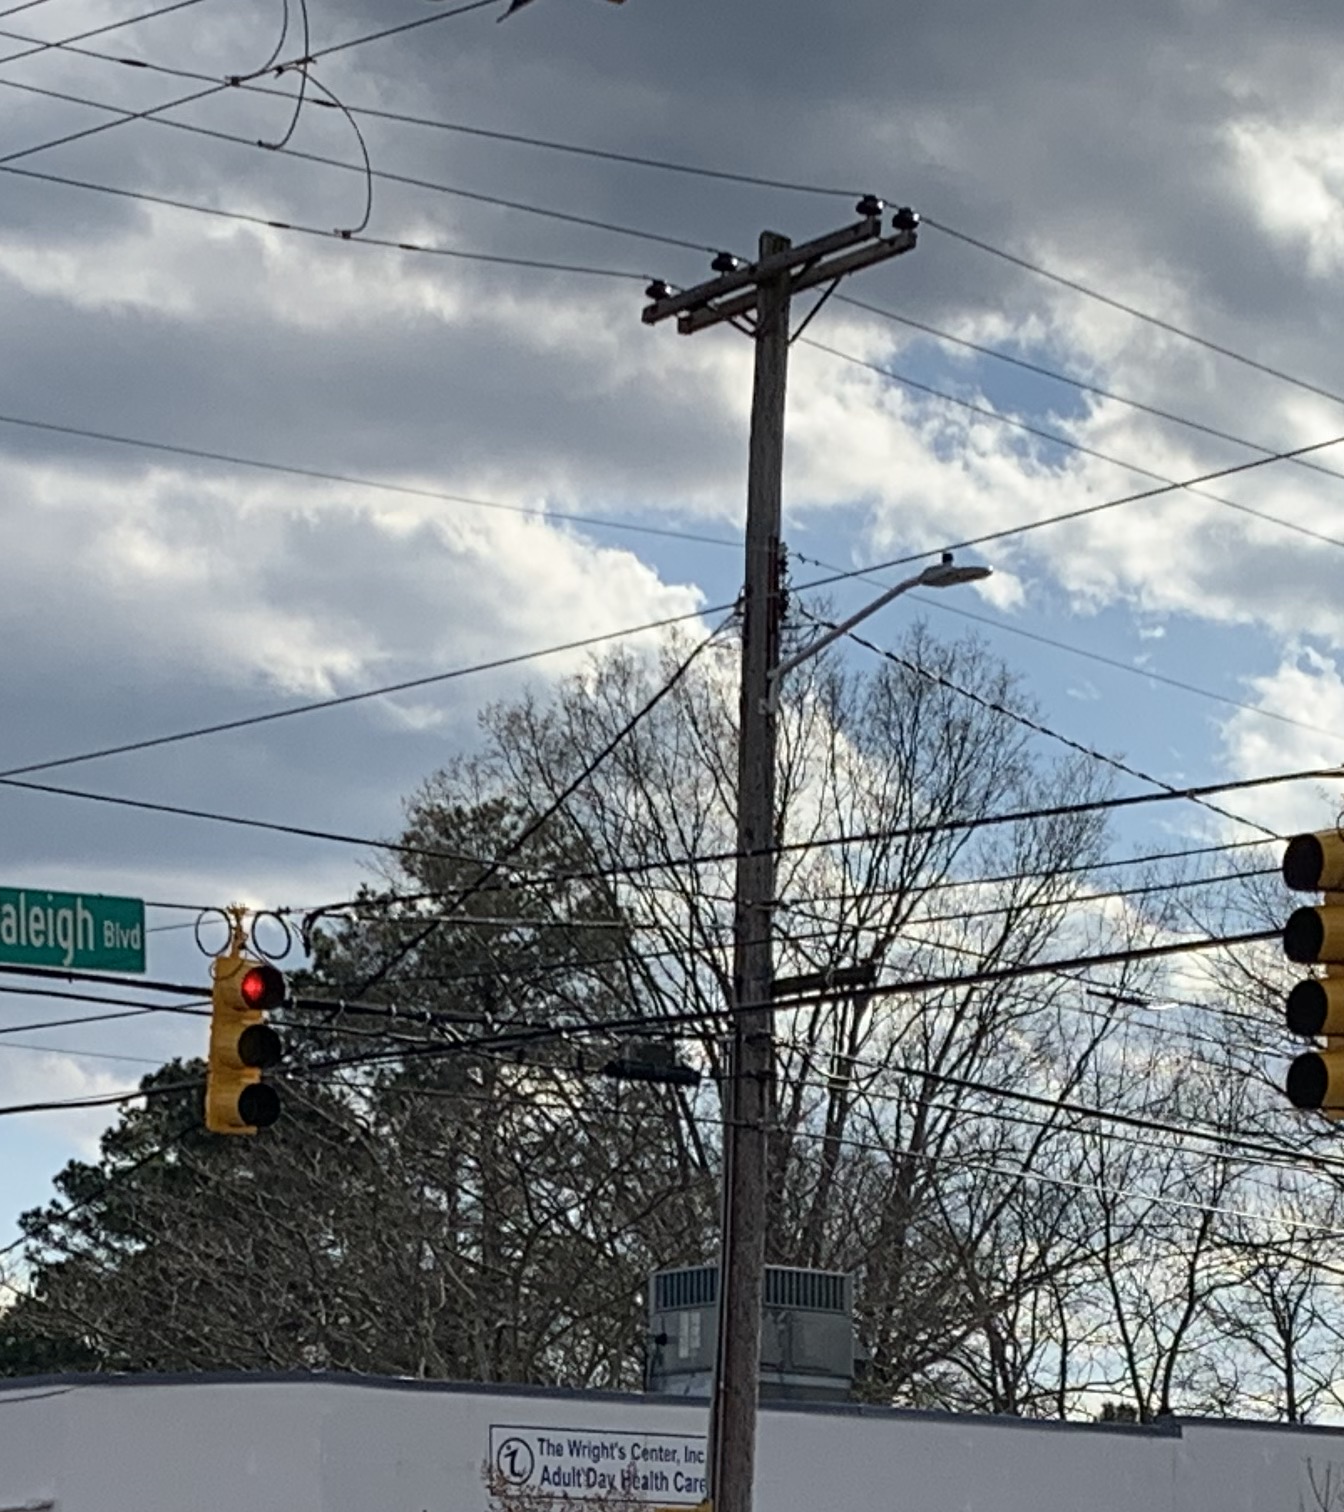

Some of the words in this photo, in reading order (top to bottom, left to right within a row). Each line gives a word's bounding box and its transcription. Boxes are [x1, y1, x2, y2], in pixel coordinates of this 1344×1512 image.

[103, 920, 142, 950] Blvd
[537, 1437, 564, 1457] The
[567, 1438, 626, 1464] Wright's
[631, 1443, 681, 1467] Center,
[540, 1465, 583, 1488] Adult
[585, 1467, 616, 1492] Day
[621, 1470, 669, 1493] Health
[673, 1471, 707, 1494] Care
